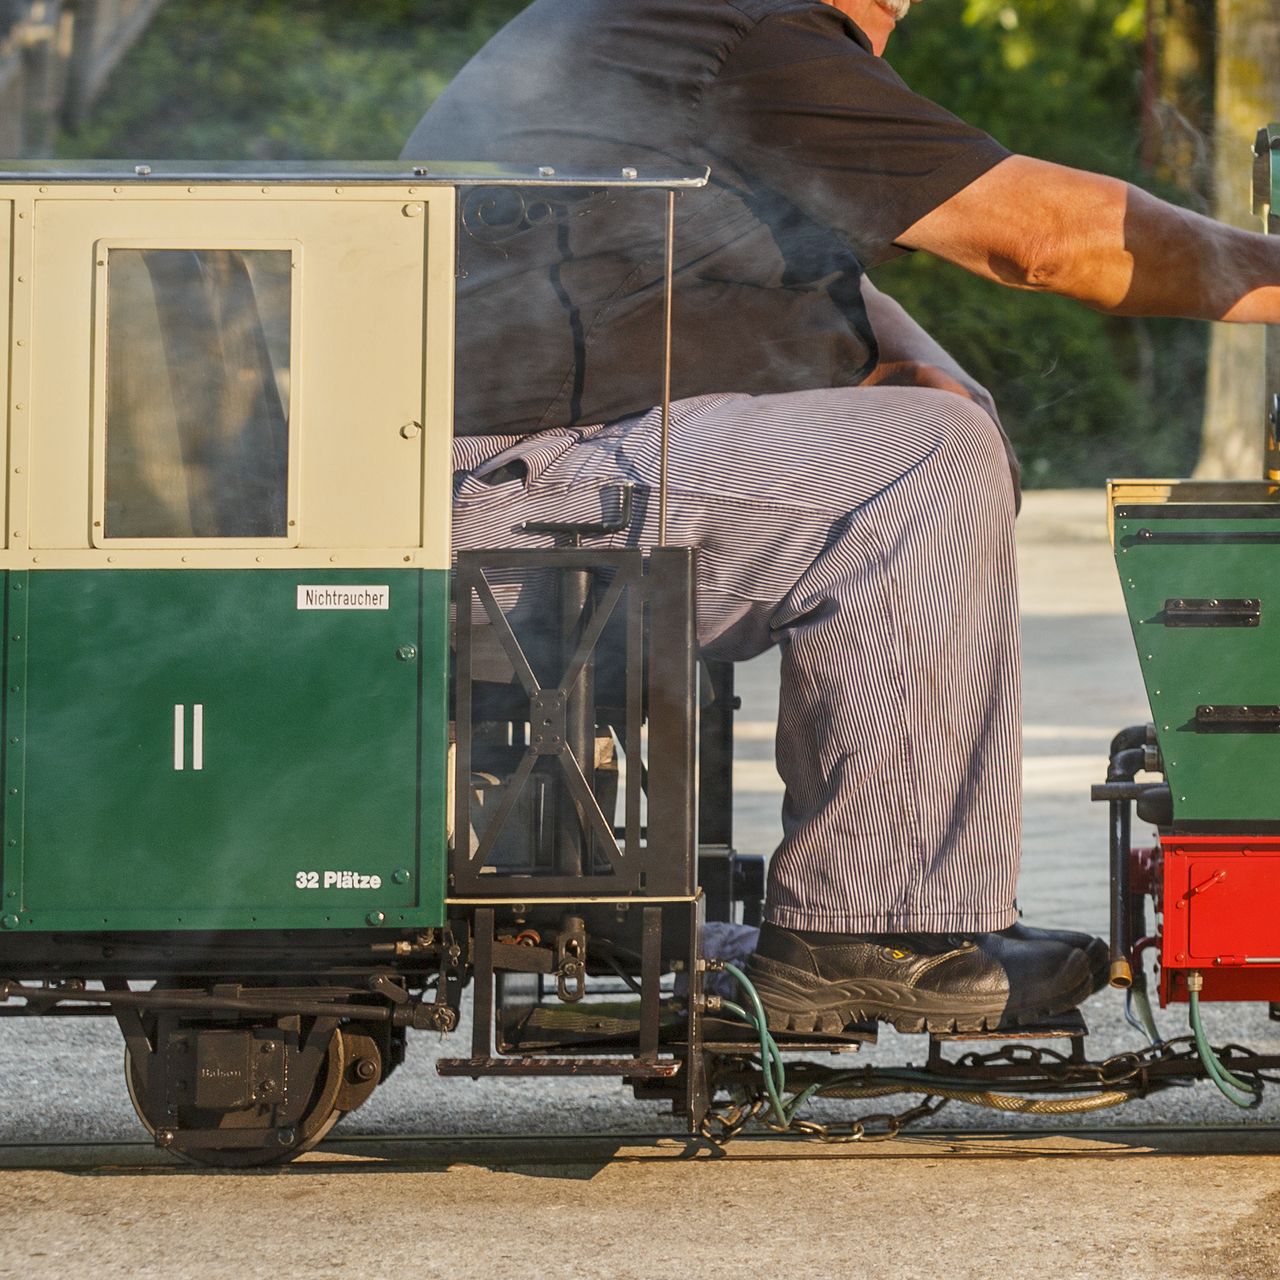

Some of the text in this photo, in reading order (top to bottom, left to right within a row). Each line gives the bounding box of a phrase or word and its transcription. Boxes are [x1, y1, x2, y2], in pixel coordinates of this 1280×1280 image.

[305, 589, 384, 607] Nichtraucher
[295, 871, 382, 889] 32 Plätze
